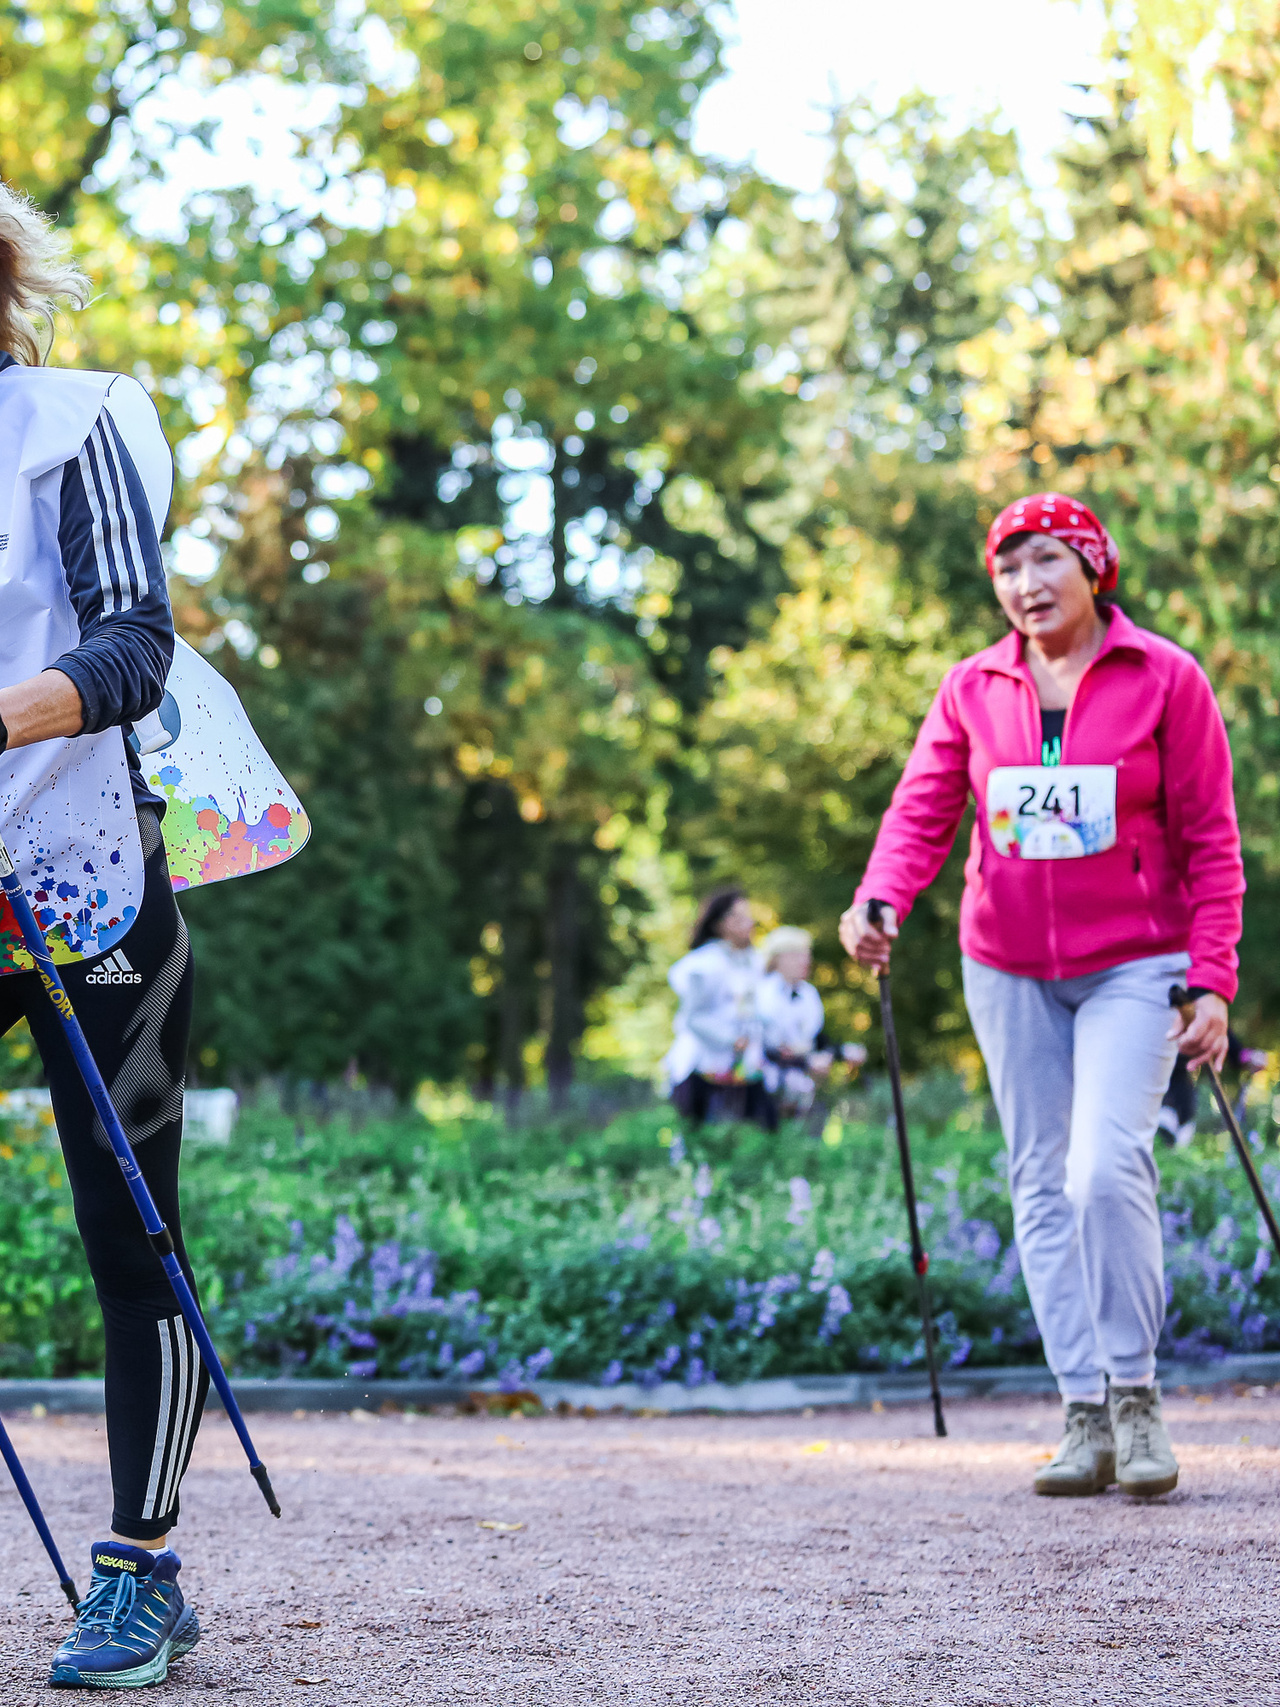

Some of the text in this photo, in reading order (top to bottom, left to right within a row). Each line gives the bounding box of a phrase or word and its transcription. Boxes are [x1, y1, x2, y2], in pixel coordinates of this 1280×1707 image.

[1018, 785, 1080, 816] 241
[85, 971, 142, 985] adidas
[95, 1554, 124, 1569] HOKA
